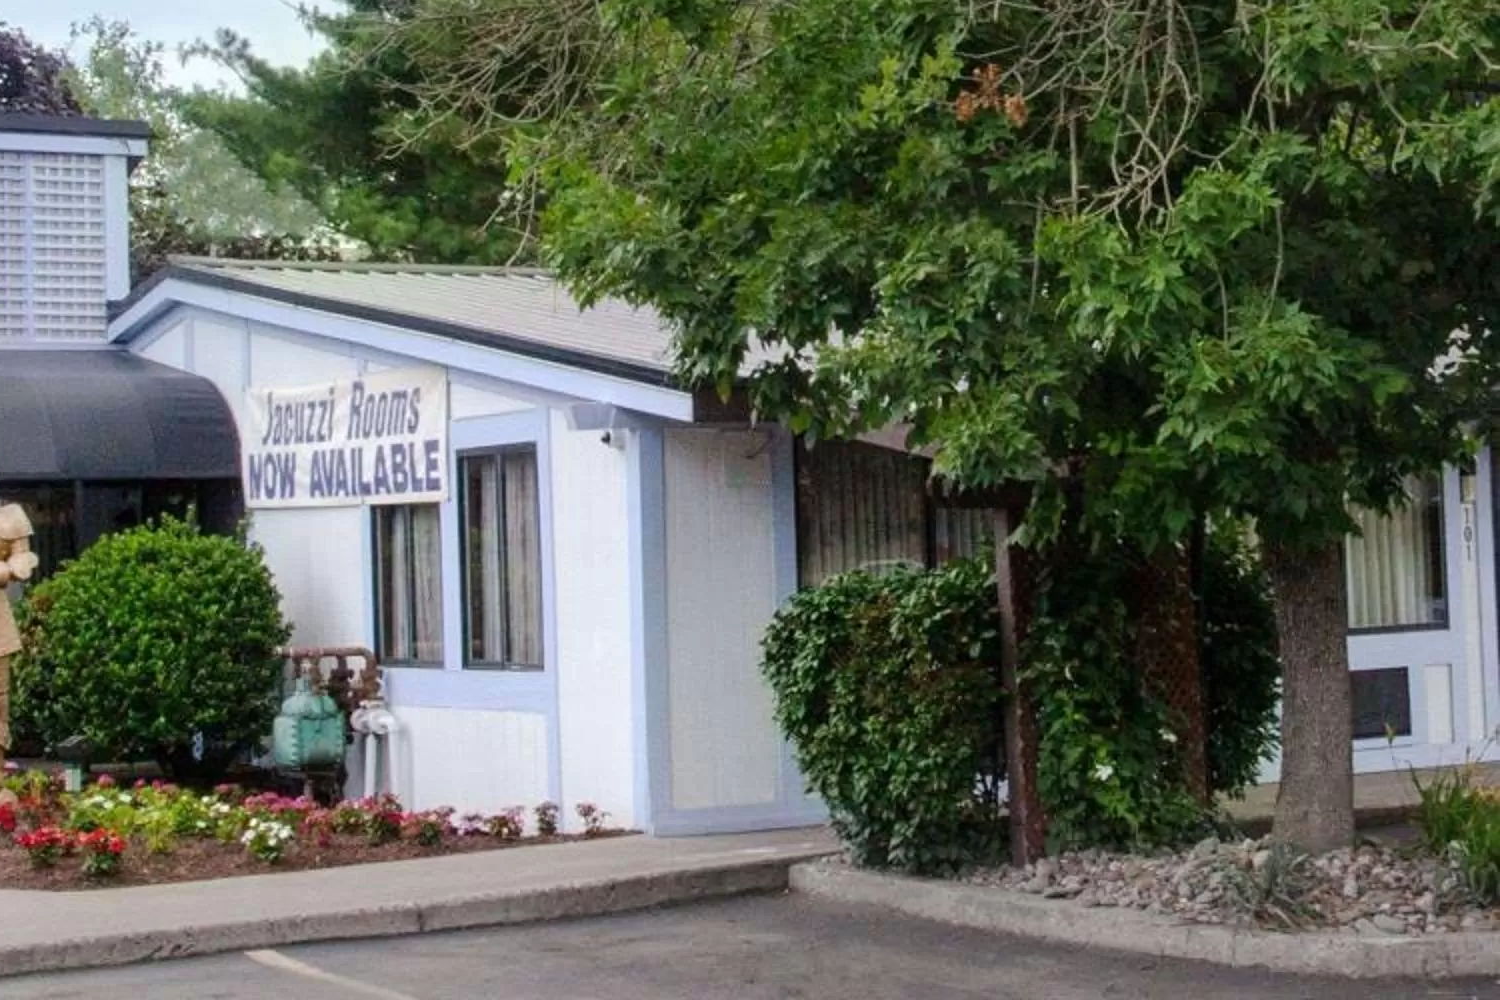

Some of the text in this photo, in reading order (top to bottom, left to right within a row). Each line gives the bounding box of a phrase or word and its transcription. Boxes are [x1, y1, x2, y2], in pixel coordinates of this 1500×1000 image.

[262, 380, 421, 445] Jacuzzi Rooms
[249, 439, 442, 499] NOW AVAILABLE
